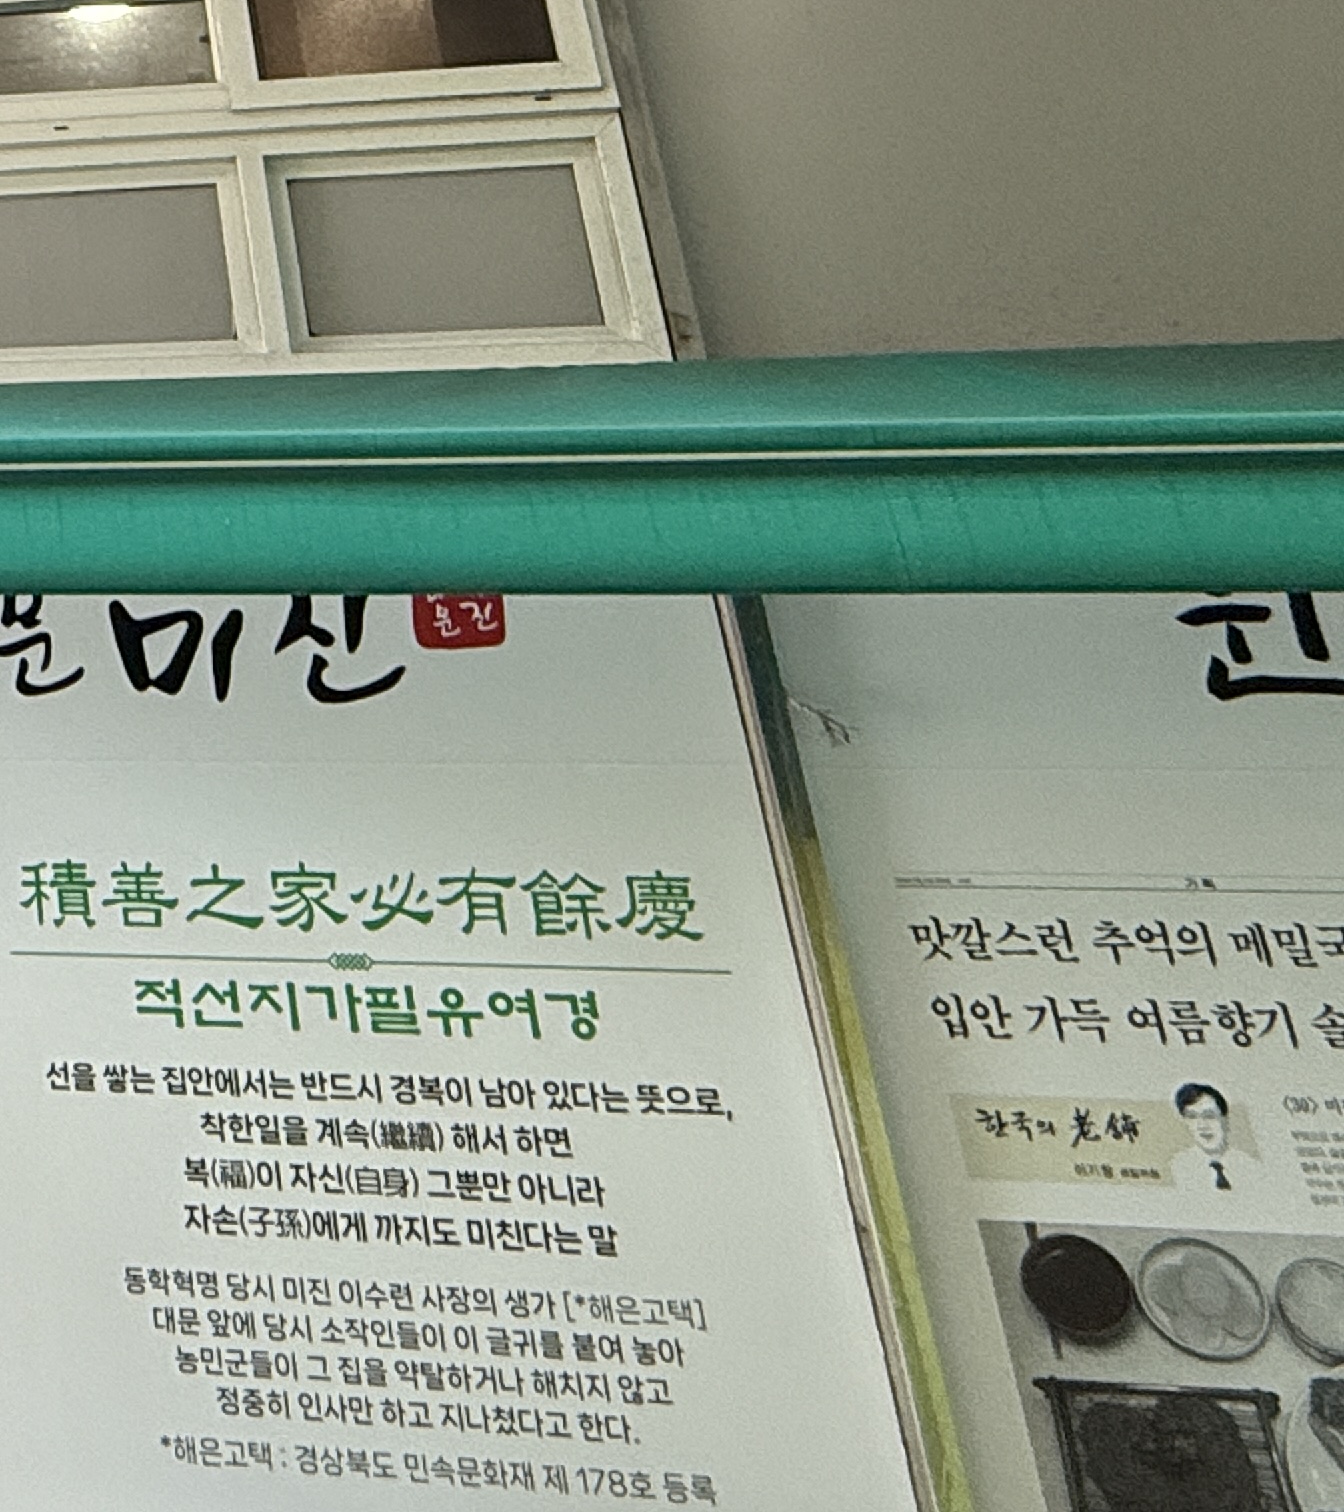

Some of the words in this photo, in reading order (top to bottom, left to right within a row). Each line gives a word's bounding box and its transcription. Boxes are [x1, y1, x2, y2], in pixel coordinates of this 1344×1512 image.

[19, 859, 705, 941] 積善之家必有餘慶
[909, 914, 1080, 964] 맛깔스런
[1092, 919, 1218, 968] 추억의
[133, 978, 600, 1040] 적선지가필유여경
[930, 992, 1013, 1041] 입안
[1023, 994, 1110, 1044] 가득
[1127, 997, 1300, 1050] 여름향기
[46, 1061, 97, 1092] 선을
[102, 1063, 155, 1094] 쌓는
[162, 1066, 295, 1100] 집안에서는
[300, 1069, 384, 1104] 반드시
[390, 1074, 473, 1107] 경복이
[479, 1076, 537, 1110] 남아
[543, 1080, 630, 1114] 있다는
[636, 1083, 734, 1122] 뜻으로,
[200, 1111, 308, 1146] 착한일을
[450, 1122, 509, 1156] 해서
[514, 1125, 574, 1158] 하면
[975, 1107, 1056, 1142] 한국의
[184, 1156, 282, 1192] 복(福)이
[289, 1160, 420, 1199] 자신(自身)
[427, 1168, 512, 1204] 그뿐만
[517, 1172, 606, 1208] 아니라
[183, 1202, 369, 1243] 자손(子孫)에게
[374, 1213, 462, 1247] 까지도
[466, 1217, 583, 1255] 미친다는
[588, 1223, 619, 1258] 말
[124, 1266, 220, 1300] 동학혁명
[226, 1272, 276, 1303] 당시
[282, 1274, 332, 1306] 미진
[338, 1278, 415, 1311] 이수련
[422, 1283, 498, 1317] 사장의
[505, 1288, 556, 1320] 생가
[152, 1306, 201, 1336] 대문
[207, 1309, 257, 1339] 앞에
[263, 1312, 314, 1343] 당시
[320, 1318, 446, 1352] 소작인들이
[454, 1324, 480, 1354] 이
[485, 1327, 564, 1360] 글귀를
[572, 1332, 625, 1364] 붙여
[632, 1336, 684, 1368] 놓아
[175, 1345, 299, 1382] 농민군들이
[306, 1354, 332, 1381] 그
[338, 1356, 388, 1387] 집을
[394, 1359, 524, 1398] 약탈하거나
[531, 1369, 612, 1403] 해치지
[618, 1373, 674, 1406] 않고
[216, 1386, 292, 1420] 정중히
[297, 1391, 373, 1426] 인사만
[379, 1396, 434, 1429] 하고
[439, 1403, 573, 1439] 지나쳤다고
[577, 1411, 642, 1445] 한다.
[294, 1444, 398, 1478] 경상북도
[403, 1452, 536, 1492] 민속문화재
[543, 1464, 570, 1496] 제
[576, 1466, 657, 1500] 178호
[663, 1471, 718, 1506] 등록
